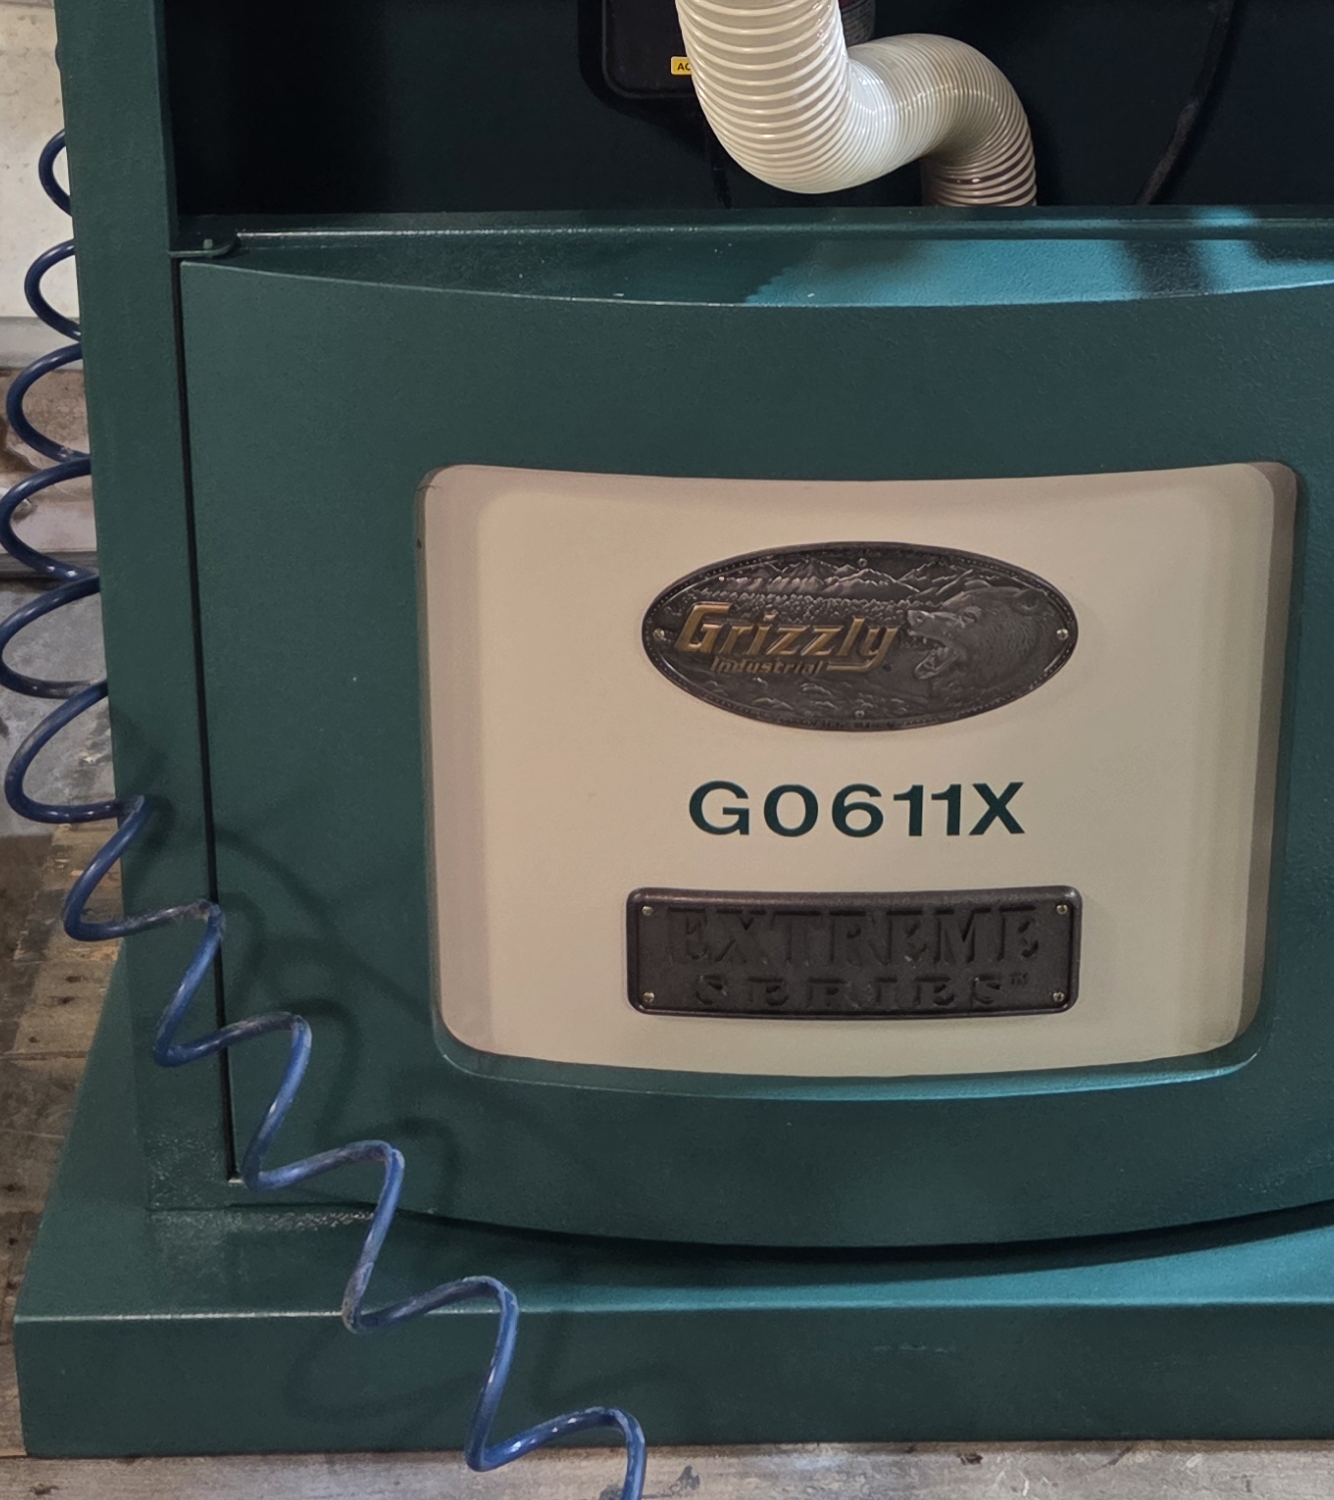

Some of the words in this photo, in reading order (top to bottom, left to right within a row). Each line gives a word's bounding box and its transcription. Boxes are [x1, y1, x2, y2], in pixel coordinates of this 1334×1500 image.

[675, 601, 899, 672] Grizzly
[711, 656, 823, 676] Industrial
[667, 905, 1041, 965] EXTREME
